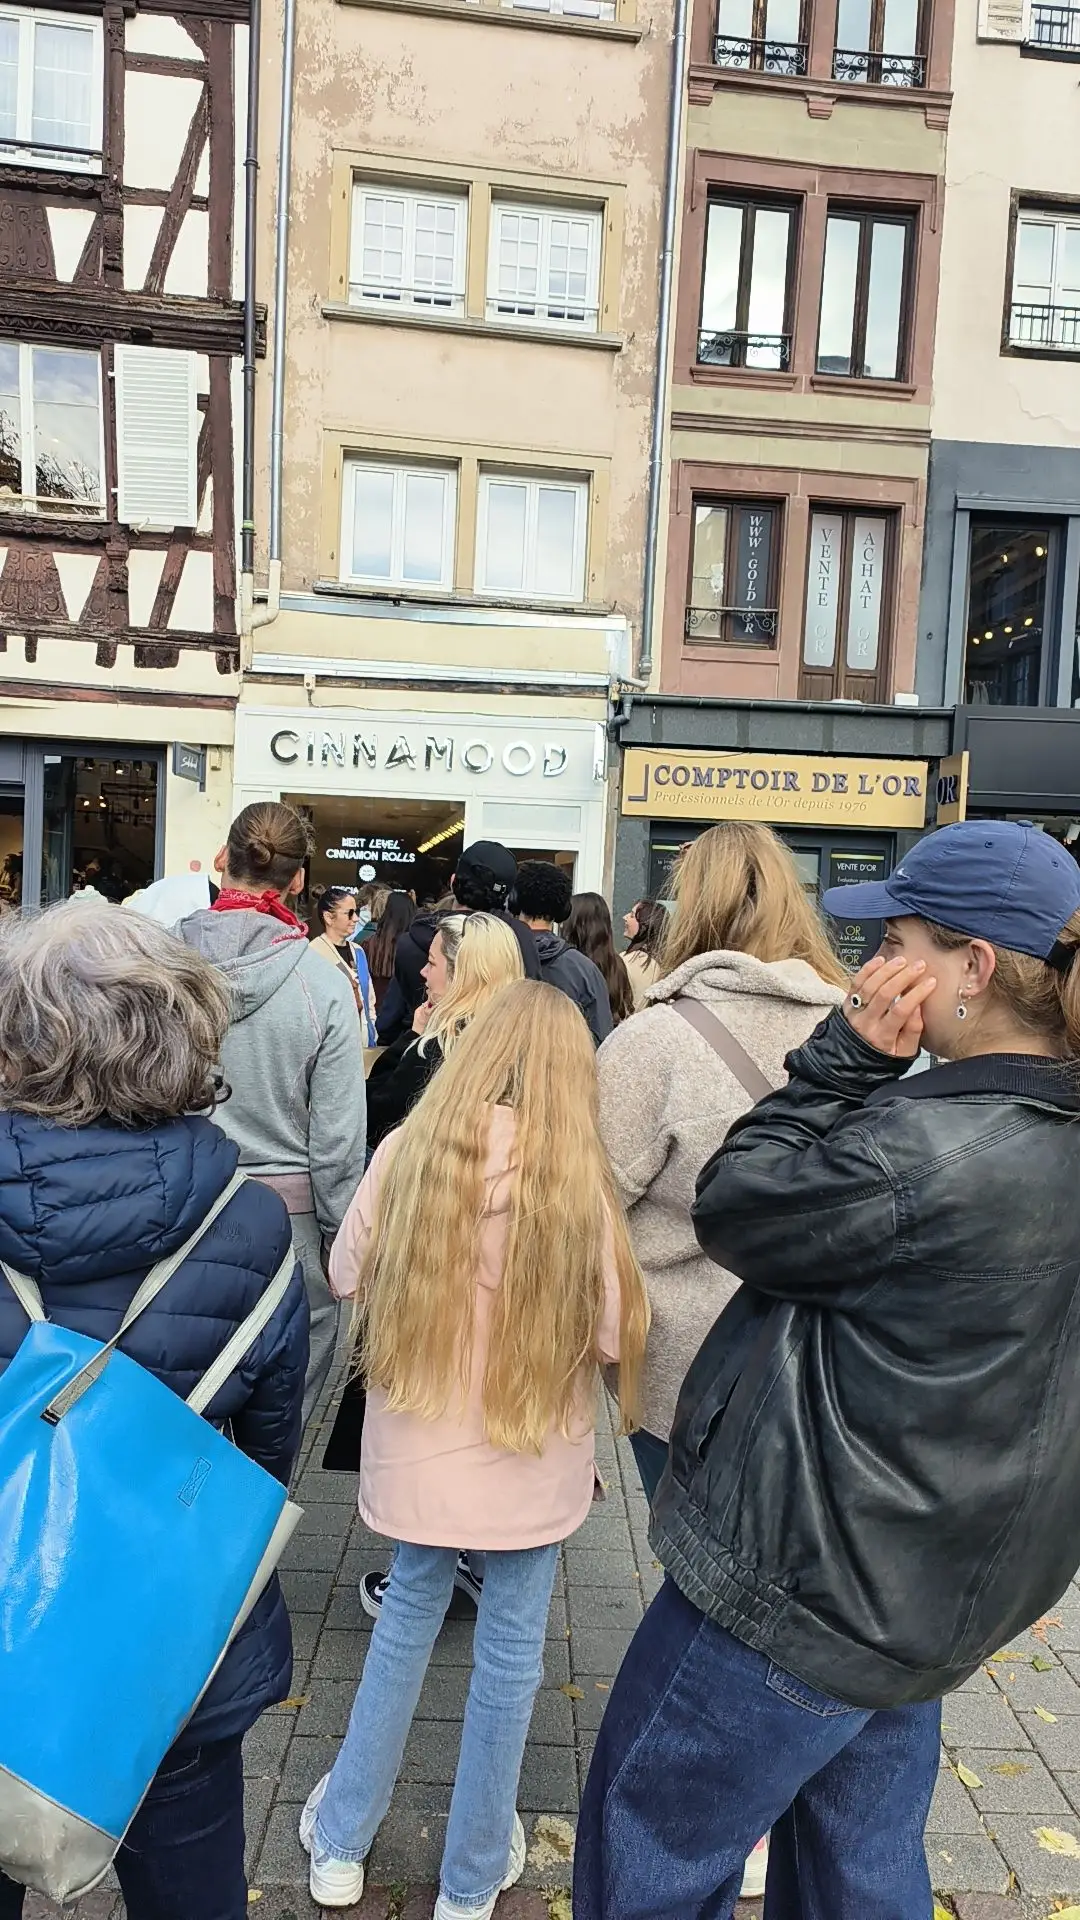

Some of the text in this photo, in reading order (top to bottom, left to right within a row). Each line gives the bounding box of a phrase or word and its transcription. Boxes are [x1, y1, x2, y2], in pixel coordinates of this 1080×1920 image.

[817, 528, 834, 607] VENTE
[859, 532, 876, 609] ACHAT
[270, 729, 569, 777] CINNAMOOD
[654, 764, 922, 796] COMPTOIR DE L'OR
[936, 774, 958, 805] OR
[653, 791, 867, 812] Professionnels de l'Or depuis 1976
[341, 837, 400, 850] NEXT LEVEL
[325, 849, 416, 863] CINNAMON ROLLS
[836, 862, 877, 872] VENTE D'OR
[845, 925, 861, 936] OR
[844, 954, 860, 965] OR
